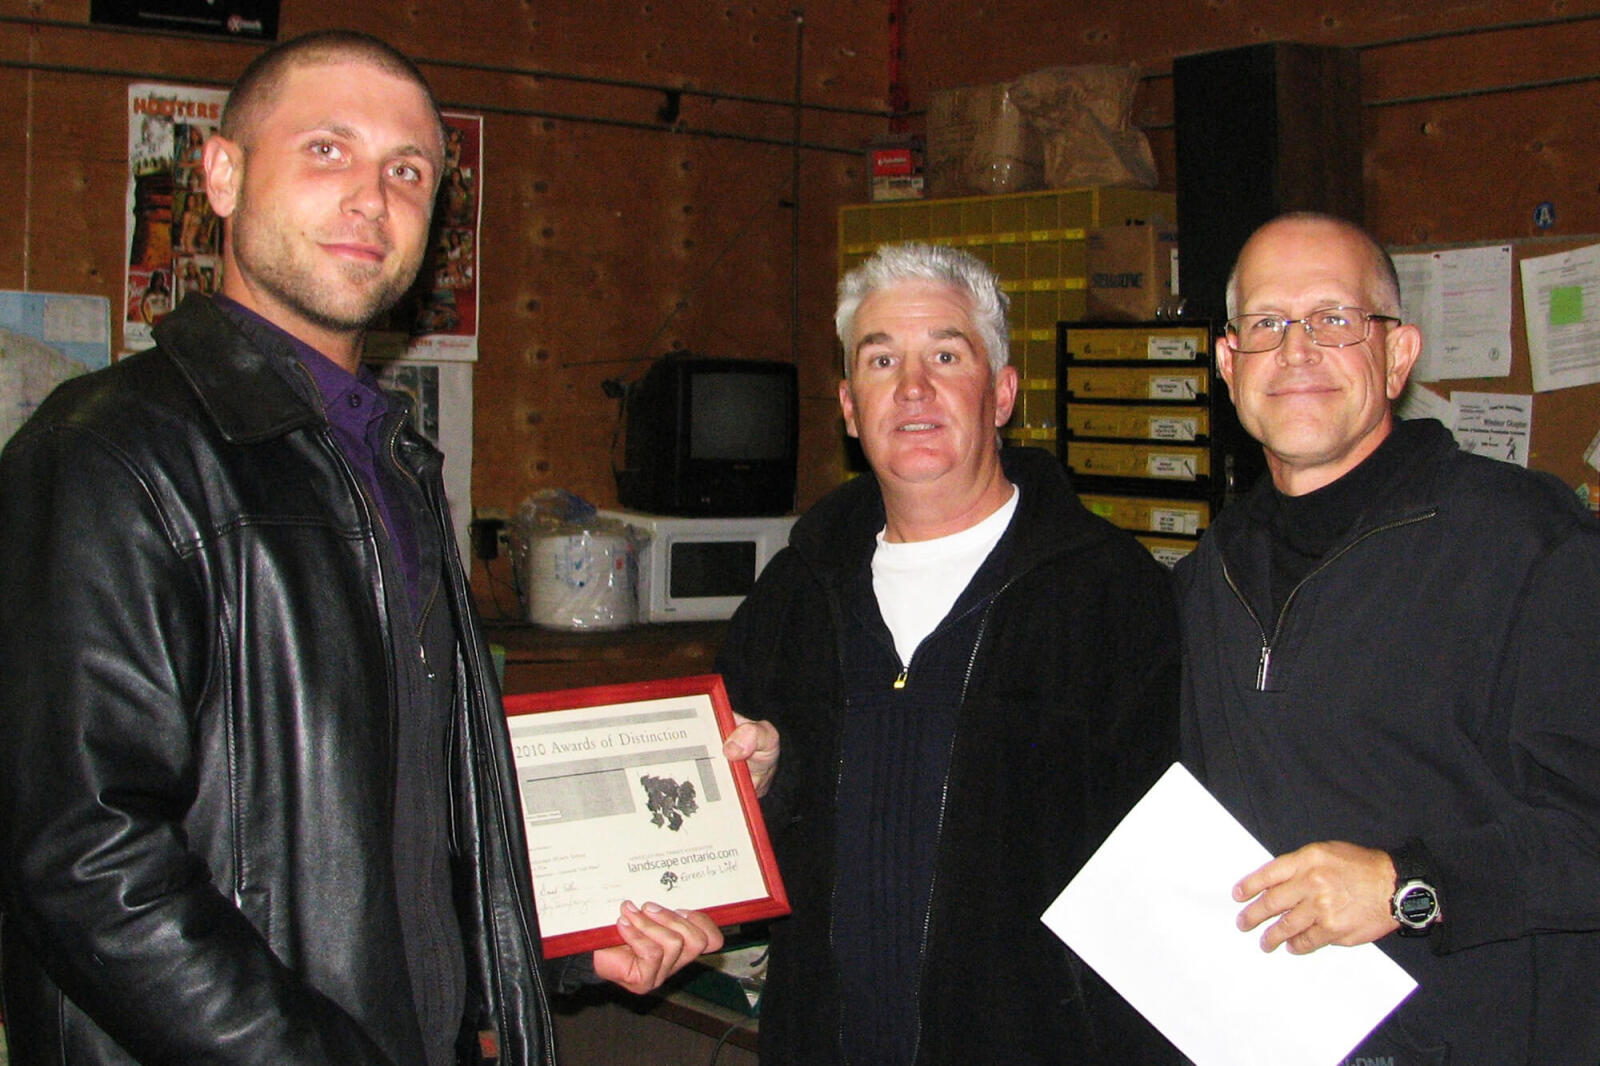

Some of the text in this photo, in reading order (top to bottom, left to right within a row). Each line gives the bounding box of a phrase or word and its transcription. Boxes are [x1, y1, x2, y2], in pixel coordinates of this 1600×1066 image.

[133, 97, 221, 119] HOOTERS
[516, 728, 688, 759] 2010 Awards of Distinction
